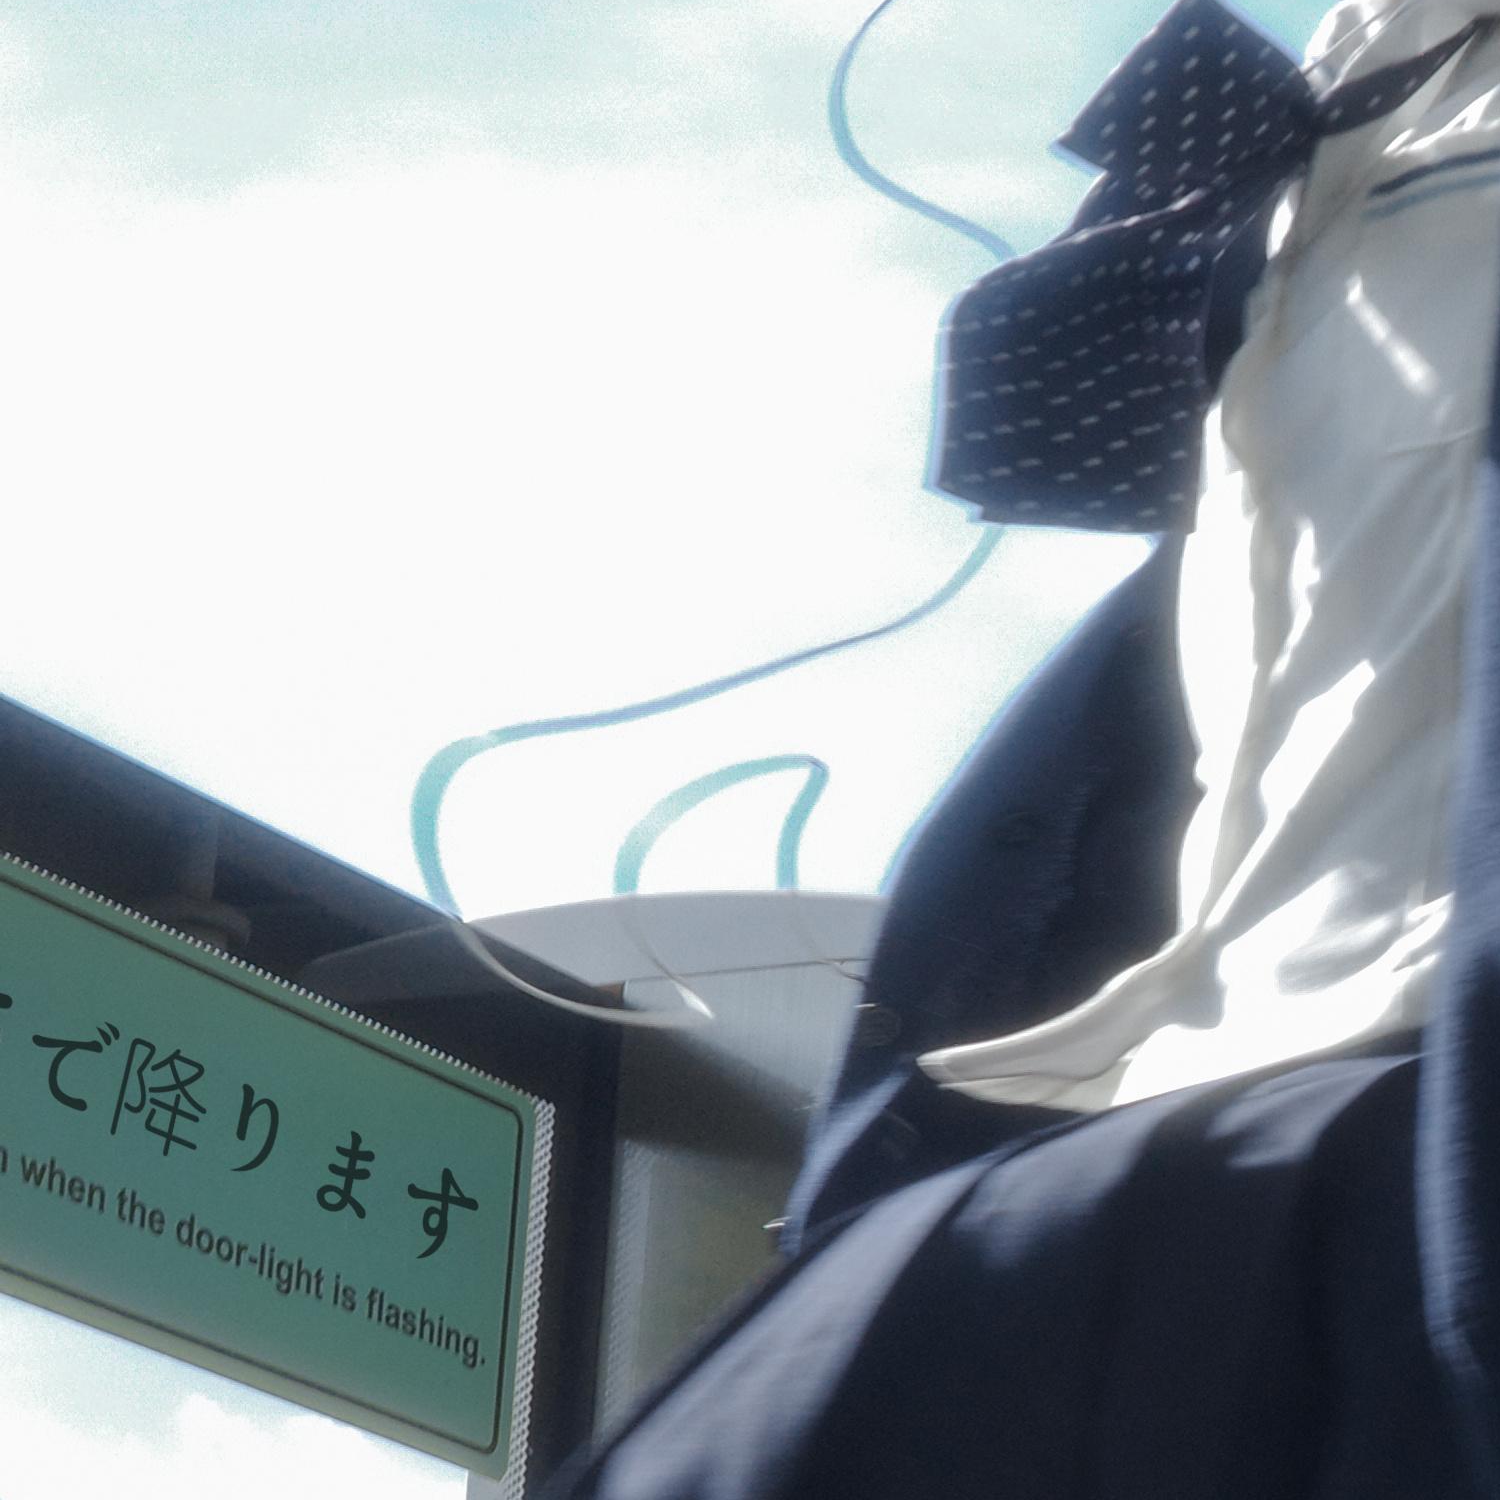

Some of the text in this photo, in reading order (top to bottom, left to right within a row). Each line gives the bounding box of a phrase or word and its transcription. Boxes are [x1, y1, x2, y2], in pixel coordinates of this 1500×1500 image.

[0, 992, 480, 1260] で降ります
[20, 1153, 106, 1214] when
[117, 1187, 165, 1236] the
[175, 1213, 325, 1299] door-light
[332, 1273, 358, 1312] is
[366, 1287, 487, 1371] flashing.
